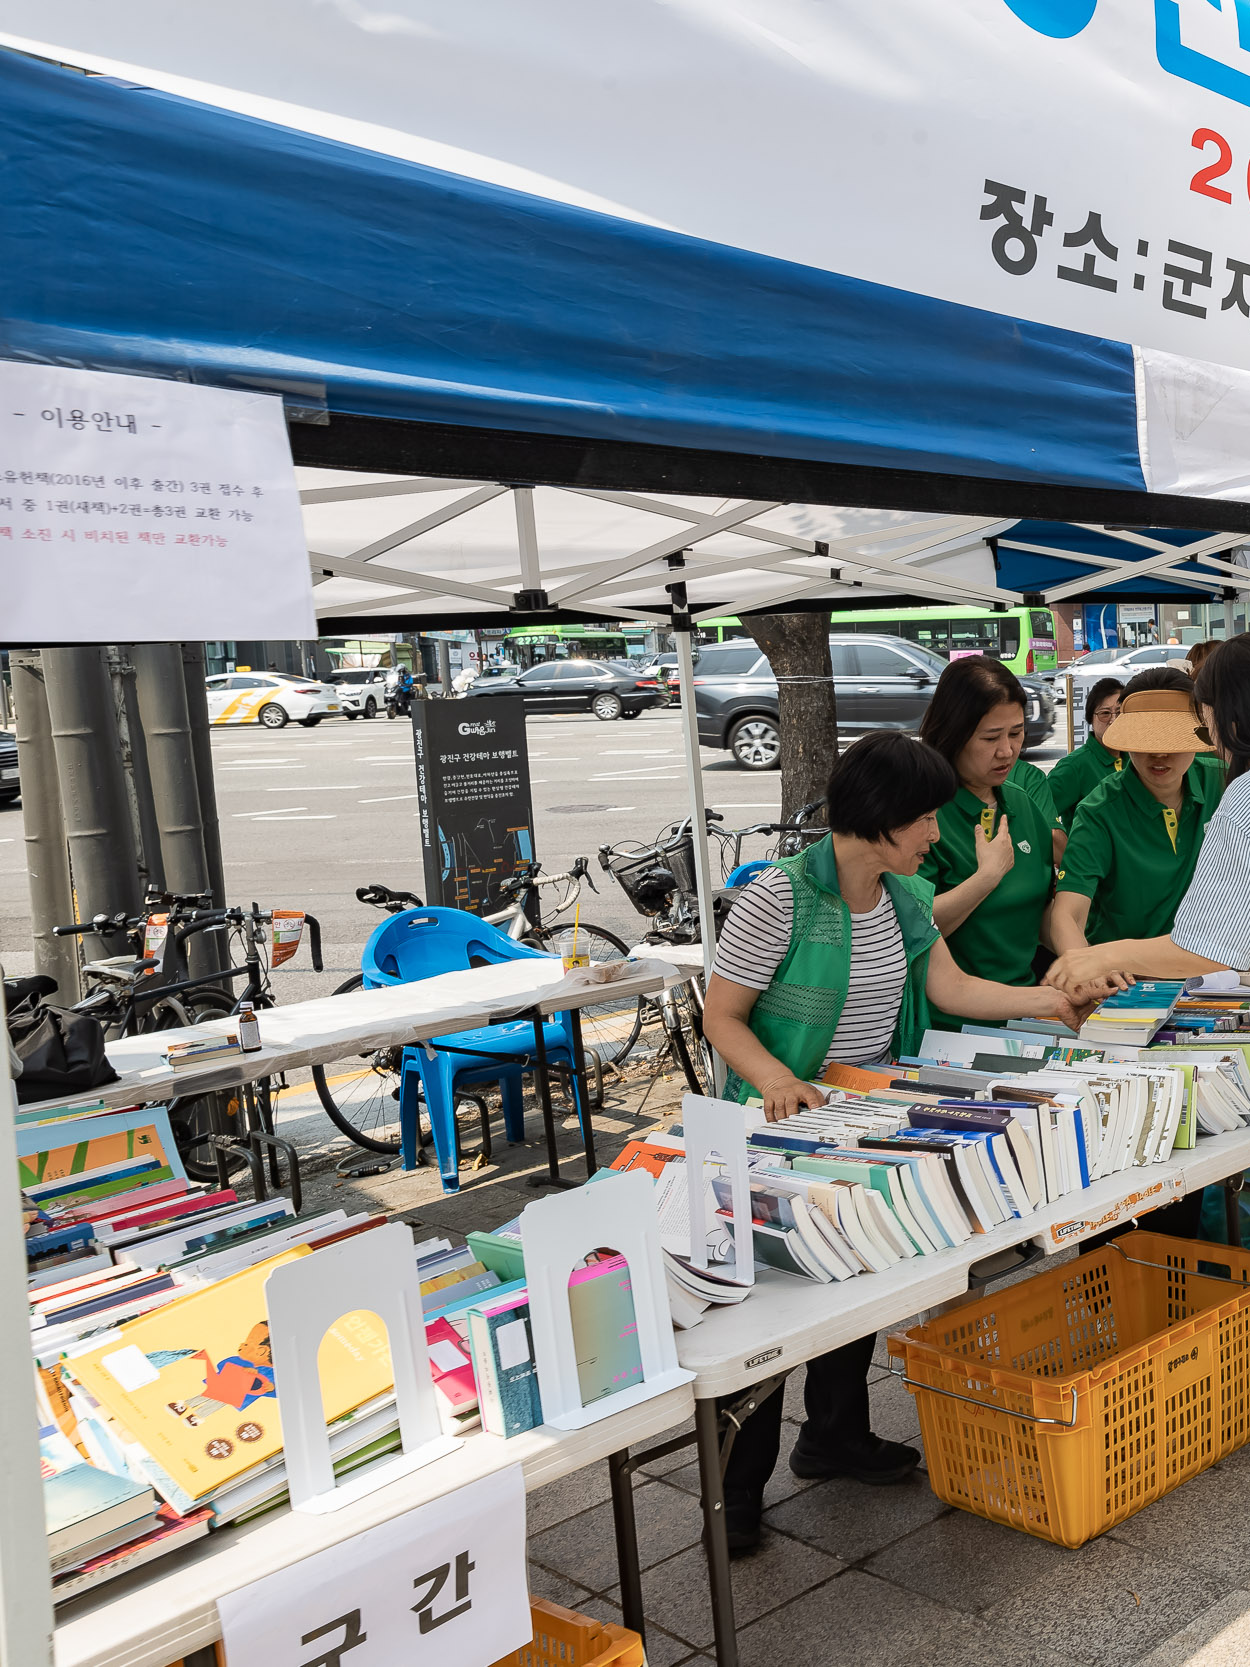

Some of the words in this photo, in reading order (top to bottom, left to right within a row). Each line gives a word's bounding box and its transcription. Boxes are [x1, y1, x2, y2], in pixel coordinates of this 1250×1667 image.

[40, 407, 137, 434] 이용안내
[114, 476, 144, 490] 이후
[151, 478, 184, 494] 출간)
[190, 481, 212, 496] 3권
[218, 482, 245, 497] 접수
[251, 485, 265, 498] 후
[21, 499, 38, 513] 중
[195, 506, 221, 520] 교환
[228, 508, 255, 523] 가능
[20, 527, 52, 542] 소진
[62, 528, 76, 542] 시
[84, 530, 129, 545] 비치된
[138, 532, 166, 546] 책만
[174, 533, 229, 548] 교환가능
[439, 754, 461, 764] 광진구
[462, 751, 490, 762] 건강테마
[492, 749, 519, 760] 보행벨트
